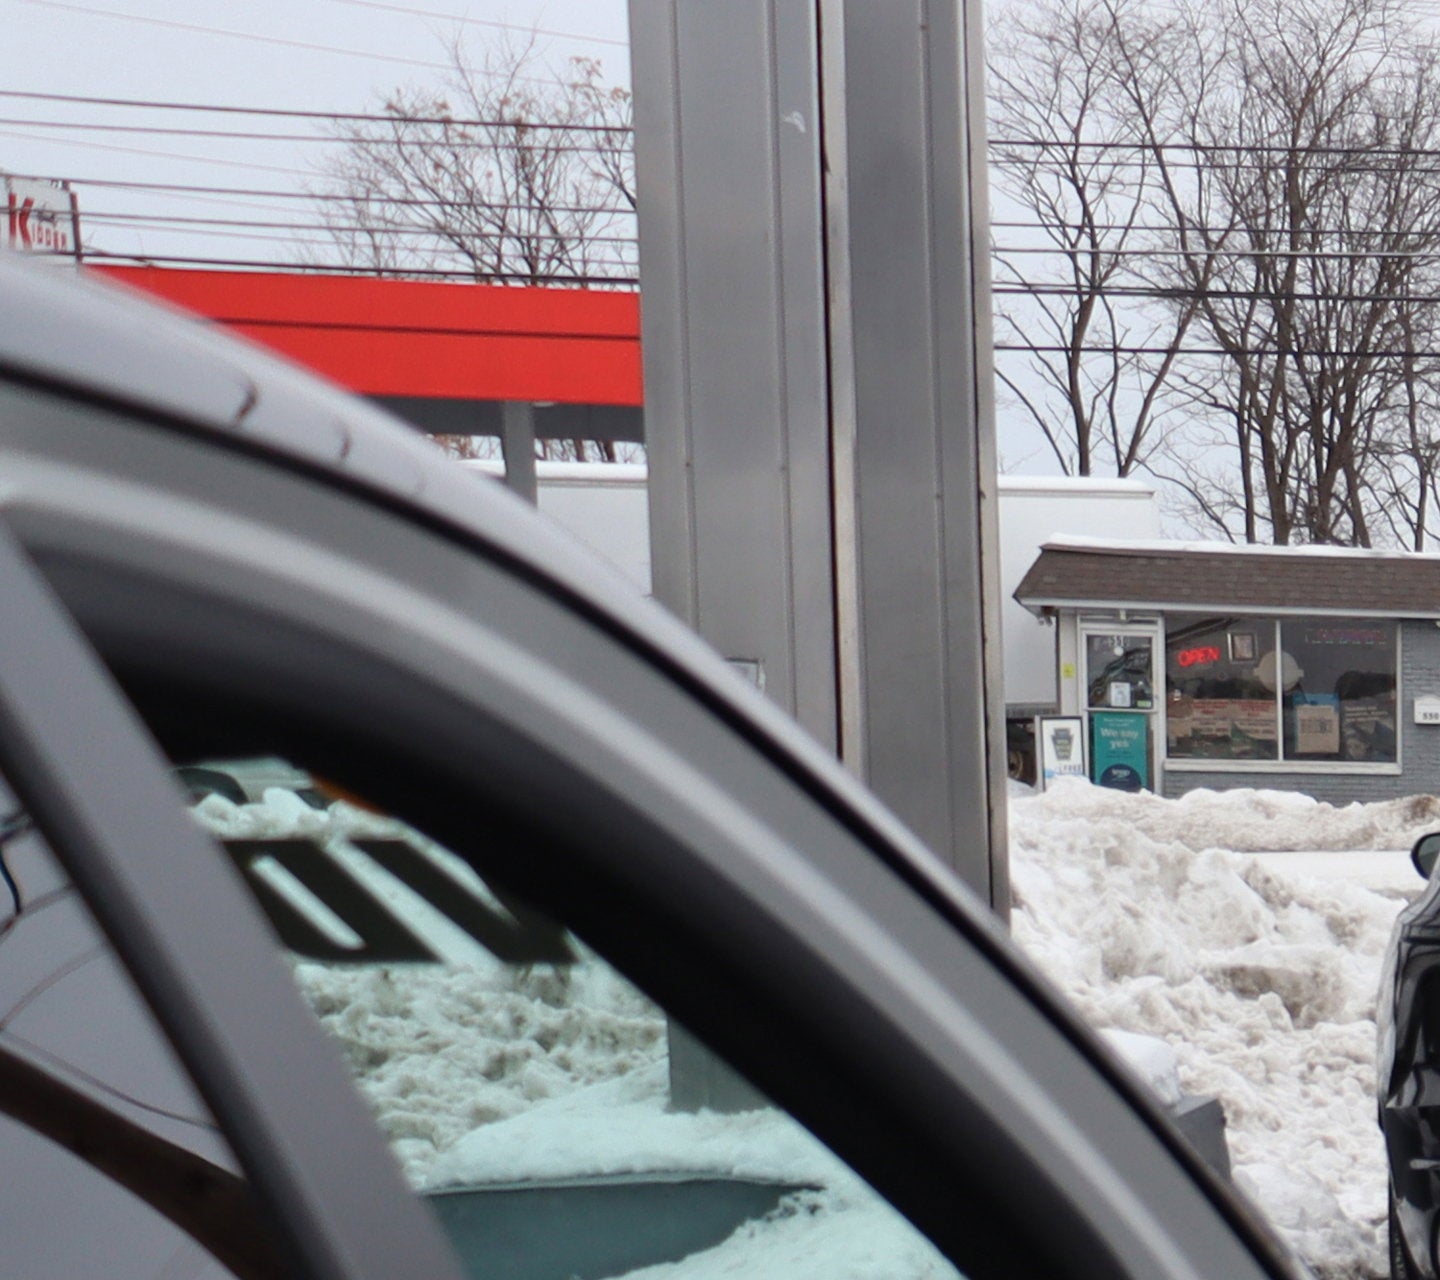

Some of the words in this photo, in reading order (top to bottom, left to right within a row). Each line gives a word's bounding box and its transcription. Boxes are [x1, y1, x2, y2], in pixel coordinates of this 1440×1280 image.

[1178, 646, 1220, 667] OPEN
[1422, 712, 1440, 720] 550
[1101, 727, 1119, 737] We
